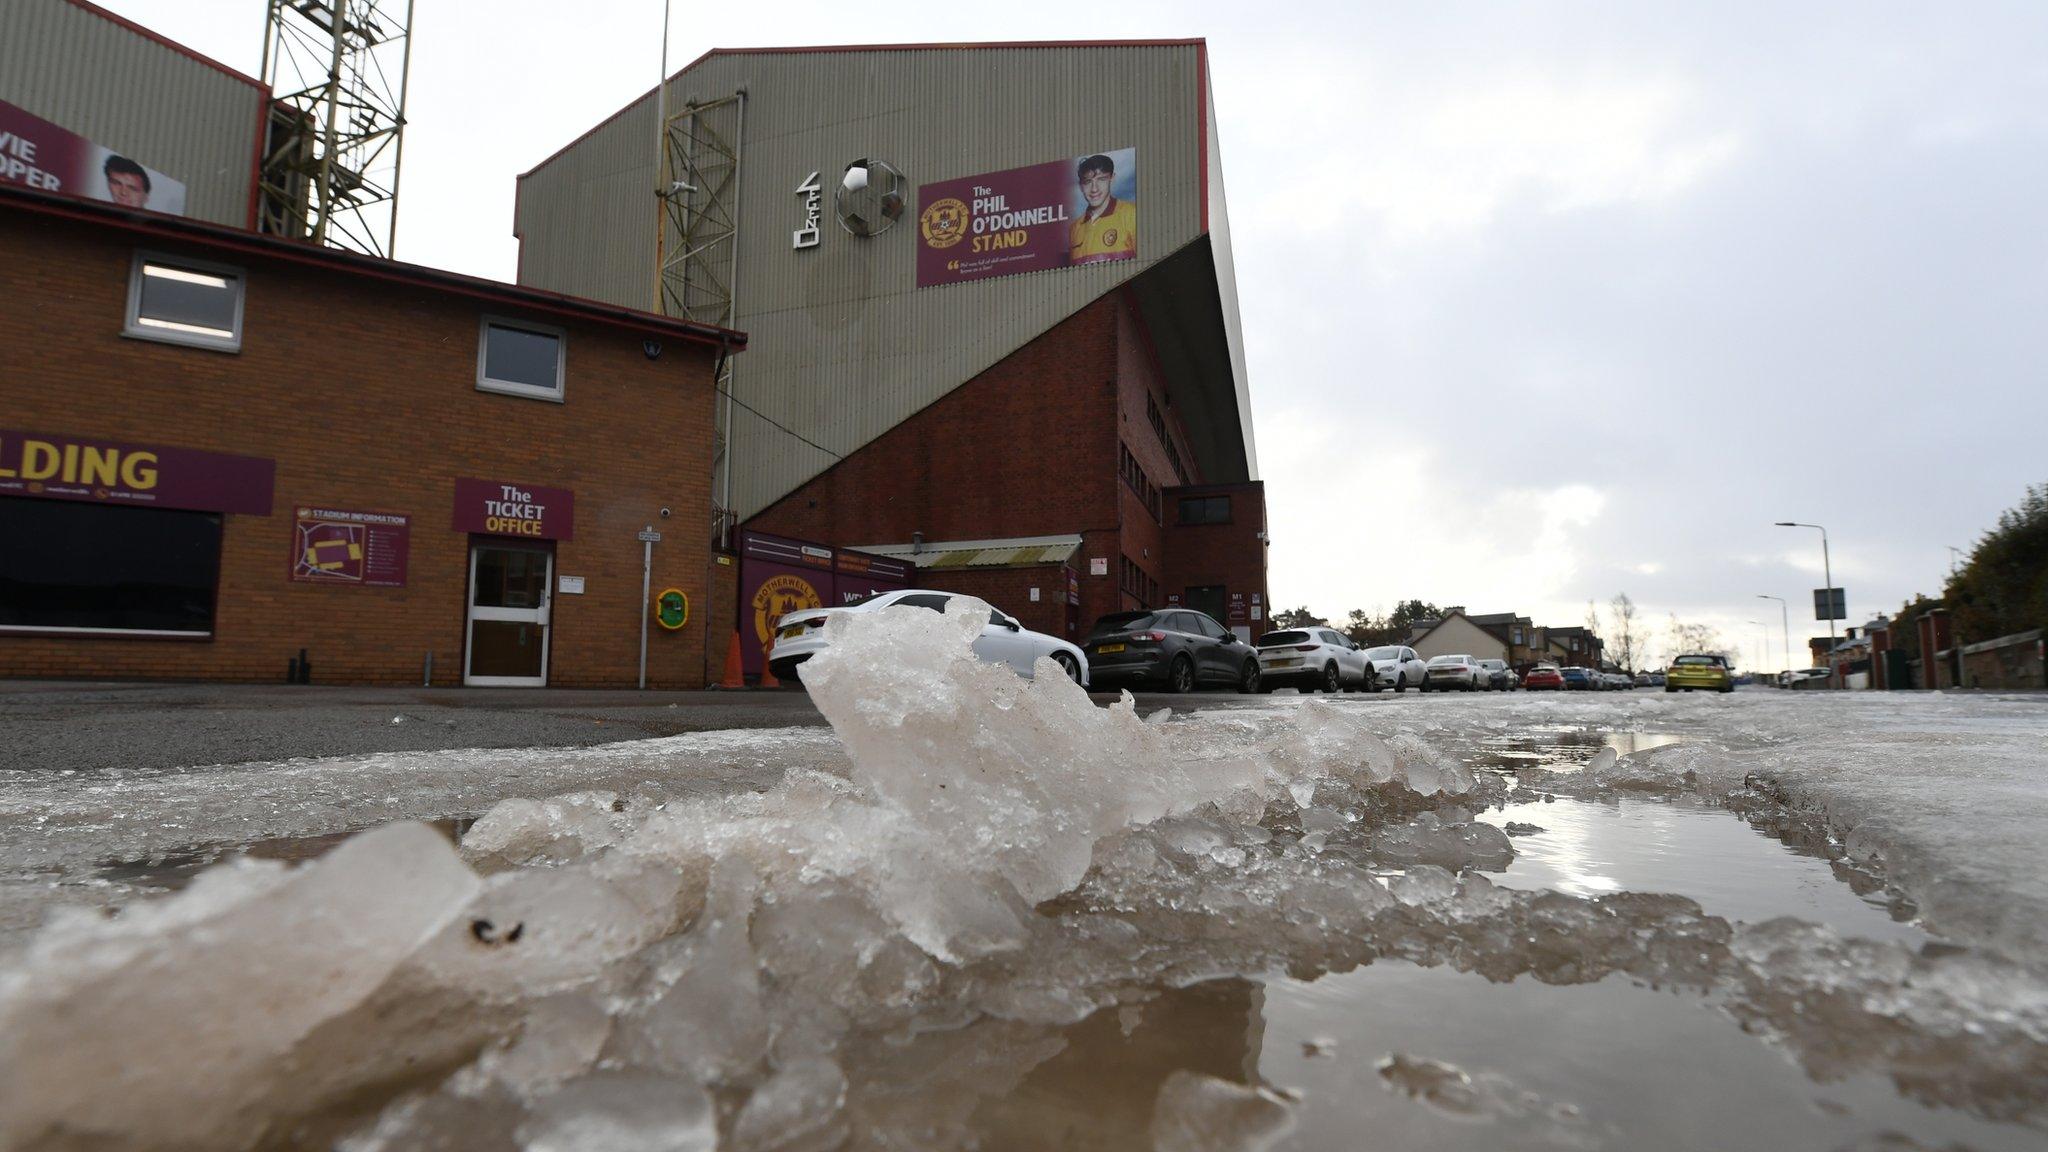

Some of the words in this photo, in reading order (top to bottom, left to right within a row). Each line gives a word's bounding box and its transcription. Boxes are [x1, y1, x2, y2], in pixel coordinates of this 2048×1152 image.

[973, 186, 992, 197] The
[972, 195, 1010, 216] PHIL
[972, 204, 1069, 234] O'DONNELL
[972, 229, 1028, 253] STAND
[501, 485, 532, 503] The
[313, 509, 350, 520] STADIUM
[350, 512, 406, 525] INFORMATION
[485, 500, 545, 520] TICKET
[485, 516, 543, 536] OFFICE
[757, 577, 809, 603] MOTHERWELL
